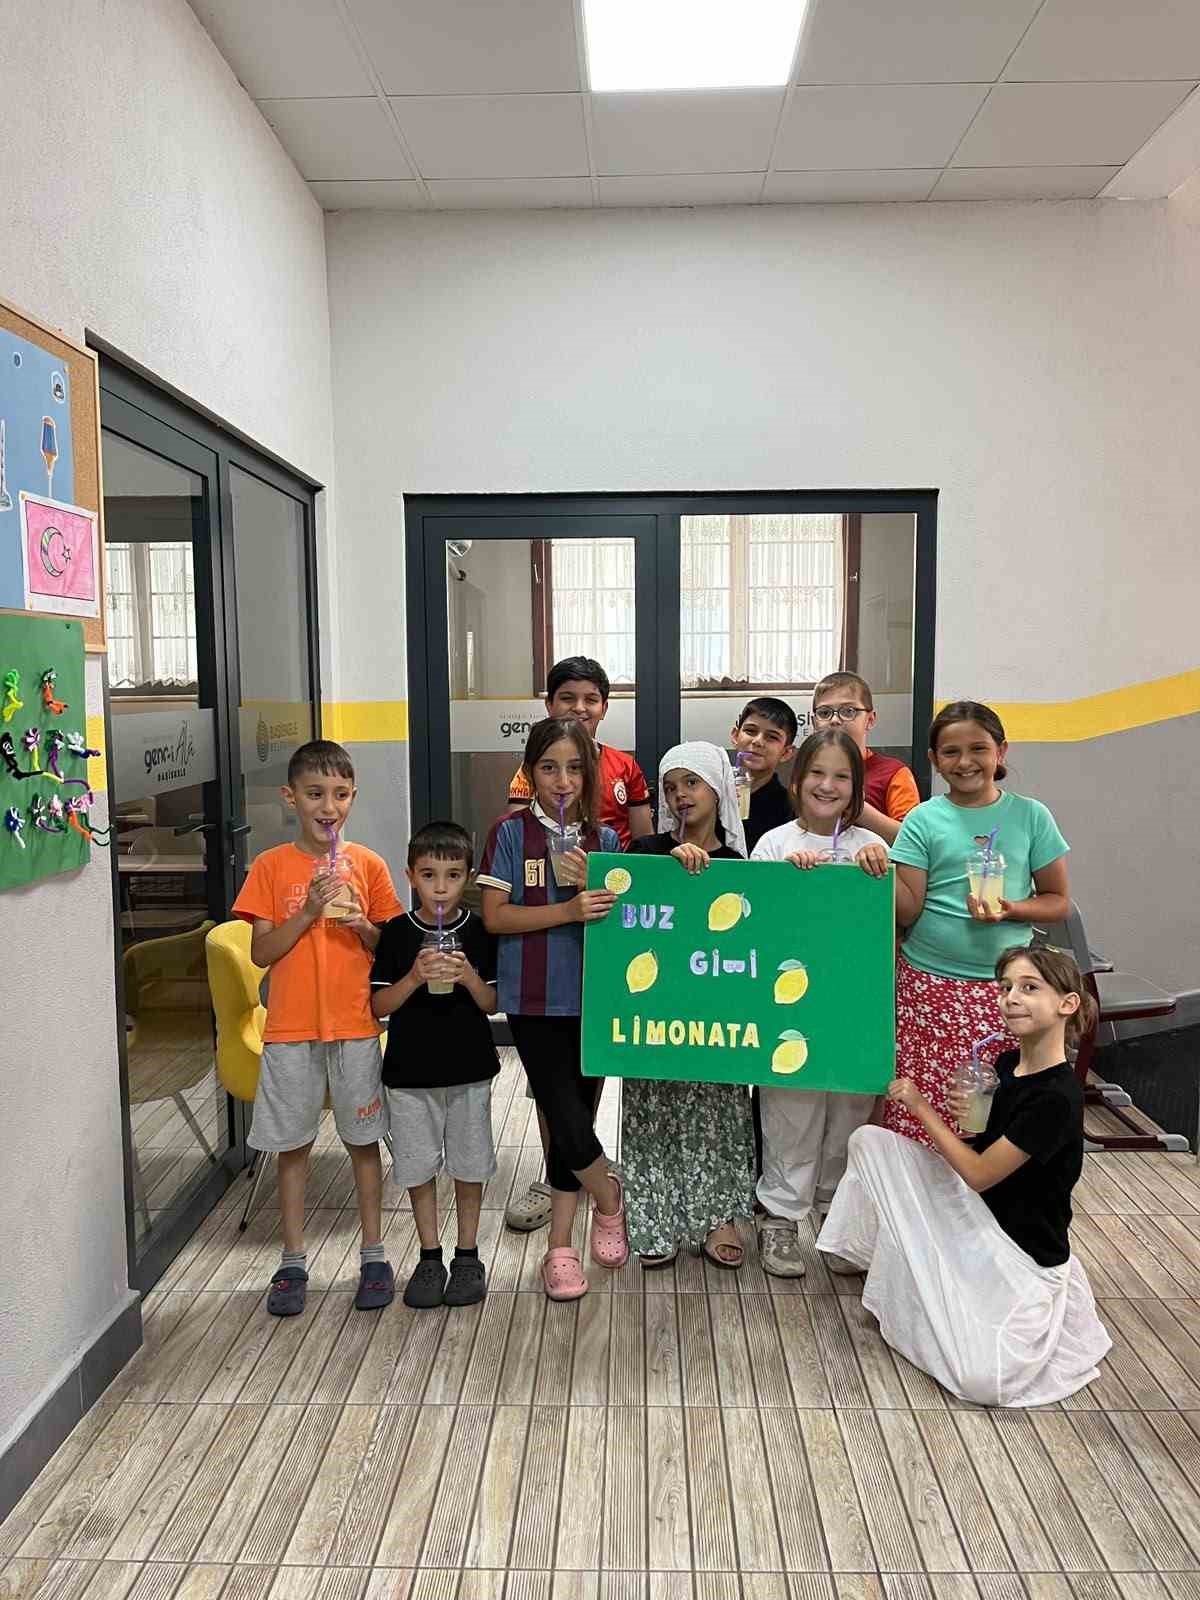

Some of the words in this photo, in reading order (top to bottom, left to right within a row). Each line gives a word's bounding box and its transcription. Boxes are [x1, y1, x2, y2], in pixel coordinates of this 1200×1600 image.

[525, 858, 545, 887] 61
[622, 903, 674, 929] BUZ
[611, 1014, 760, 1048] LİMONATA
